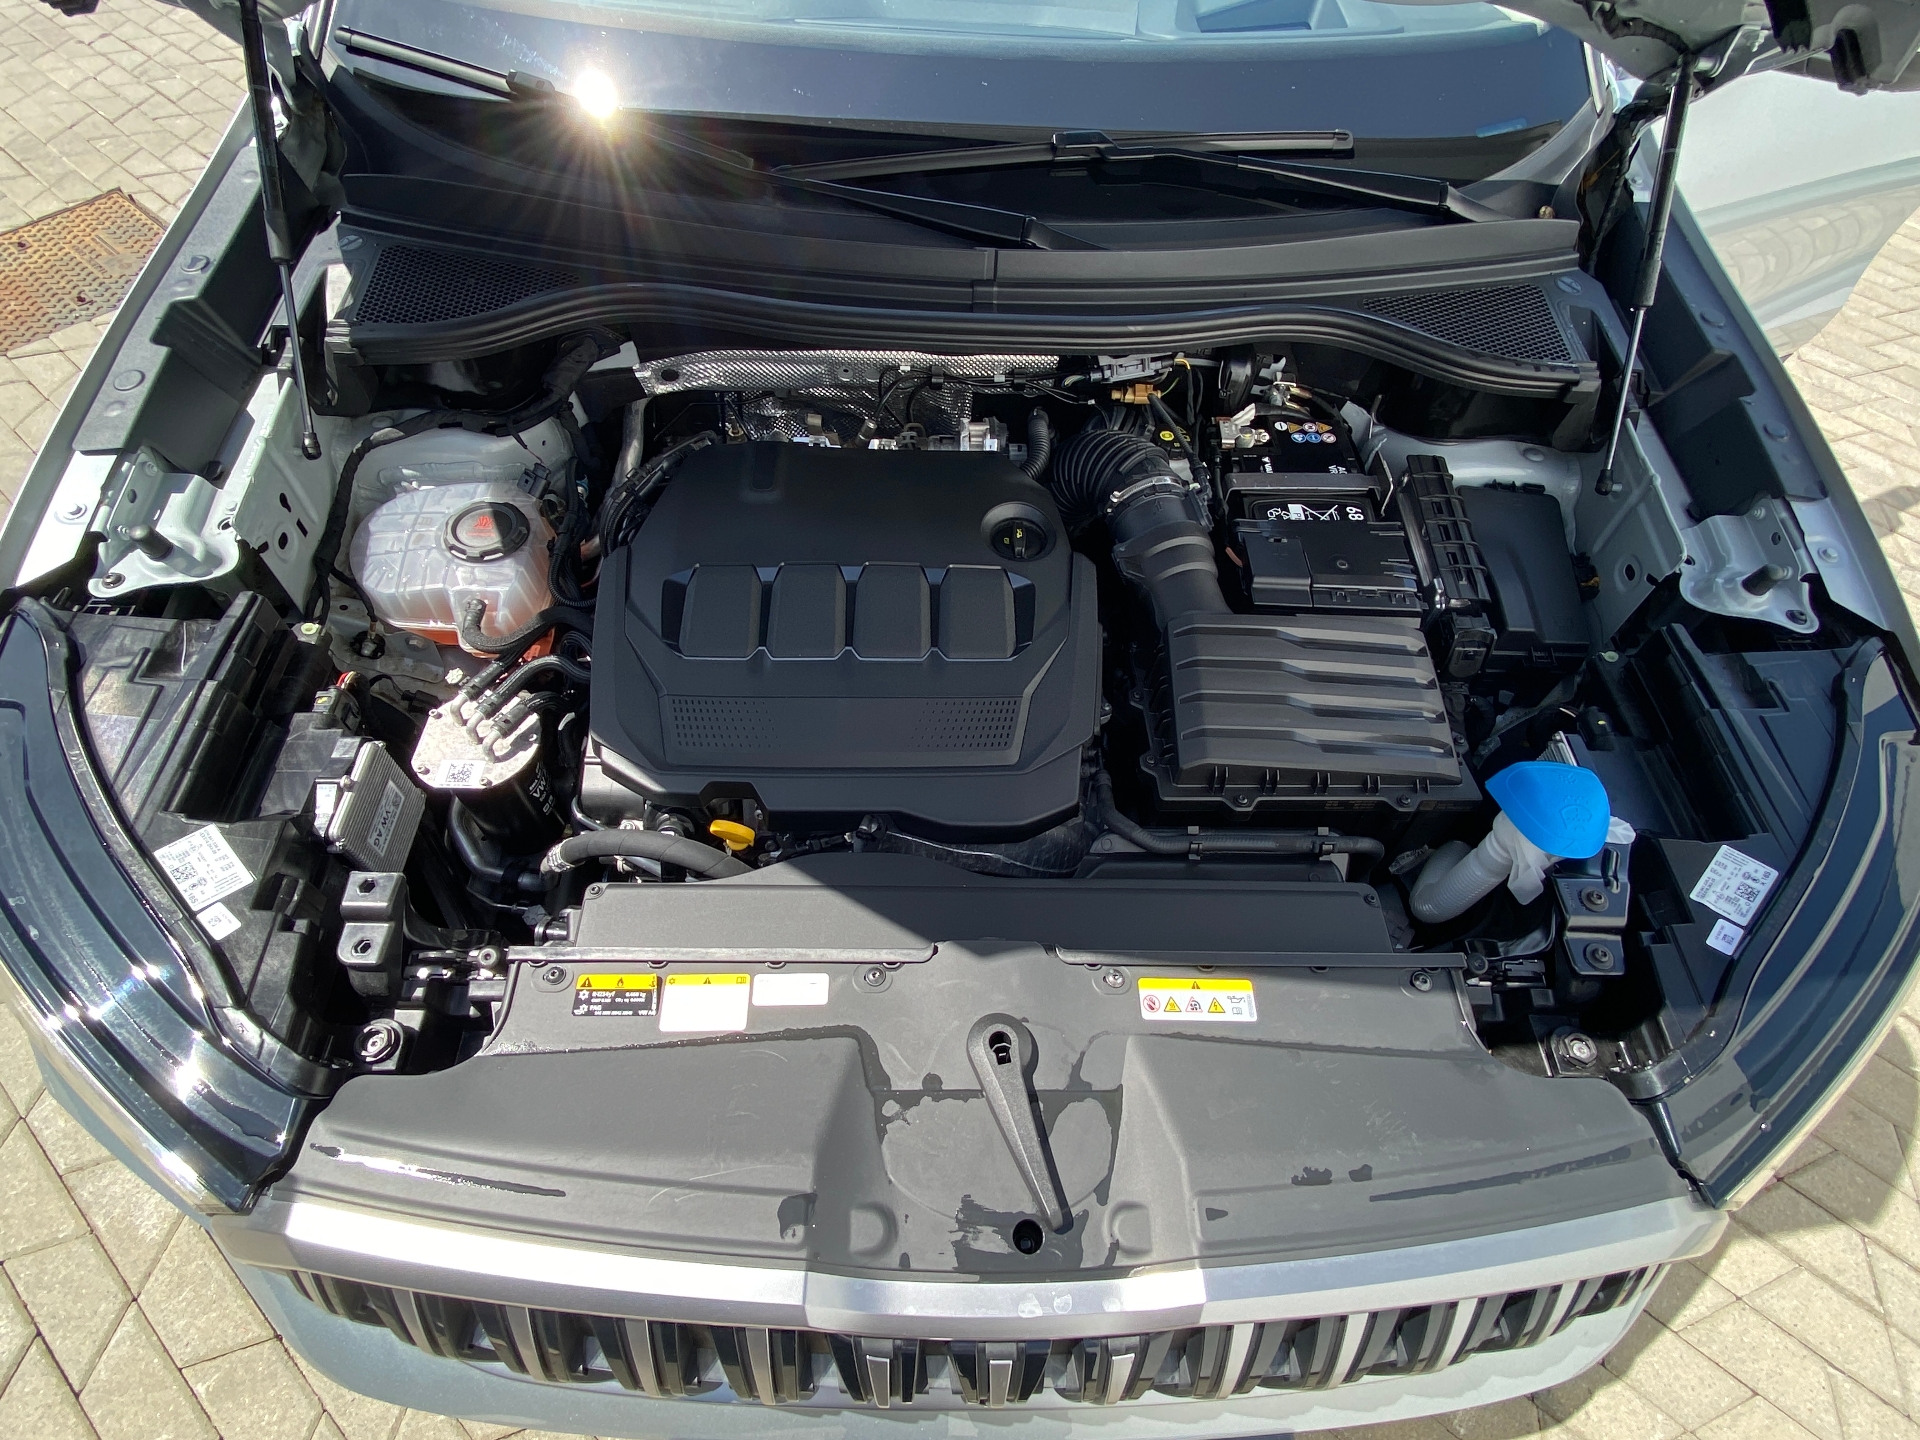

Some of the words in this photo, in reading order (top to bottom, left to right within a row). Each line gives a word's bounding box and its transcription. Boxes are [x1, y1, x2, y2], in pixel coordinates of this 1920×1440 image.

[1346, 506, 1364, 520] 68
[381, 810, 391, 829] VW
[373, 828, 382, 847] AG
